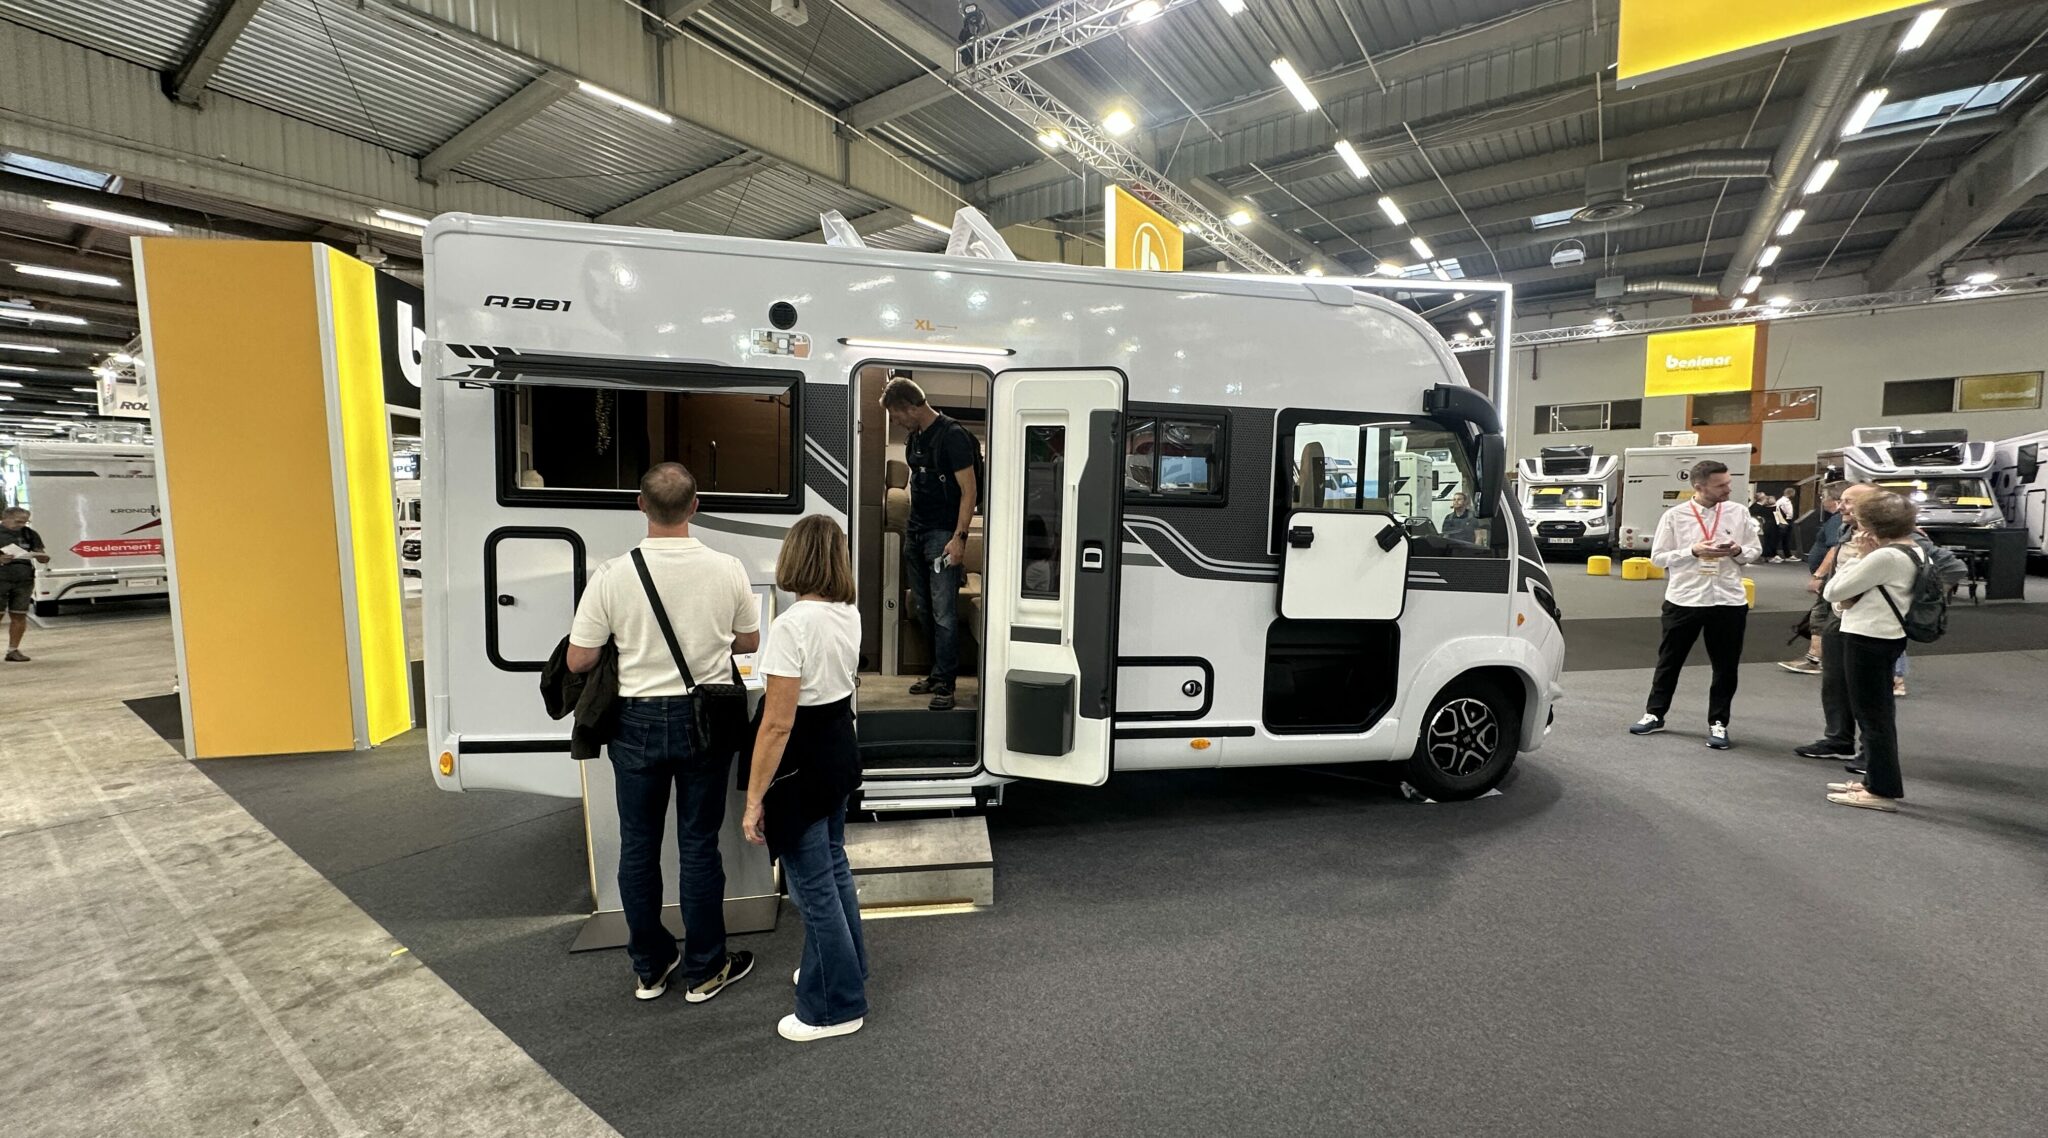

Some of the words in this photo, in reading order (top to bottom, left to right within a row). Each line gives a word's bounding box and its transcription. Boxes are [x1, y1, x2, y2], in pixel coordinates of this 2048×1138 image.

[484, 295, 571, 312] A981
[914, 319, 936, 331] XL
[1666, 355, 1732, 368] benimar
[82, 544, 151, 552] Seulement
